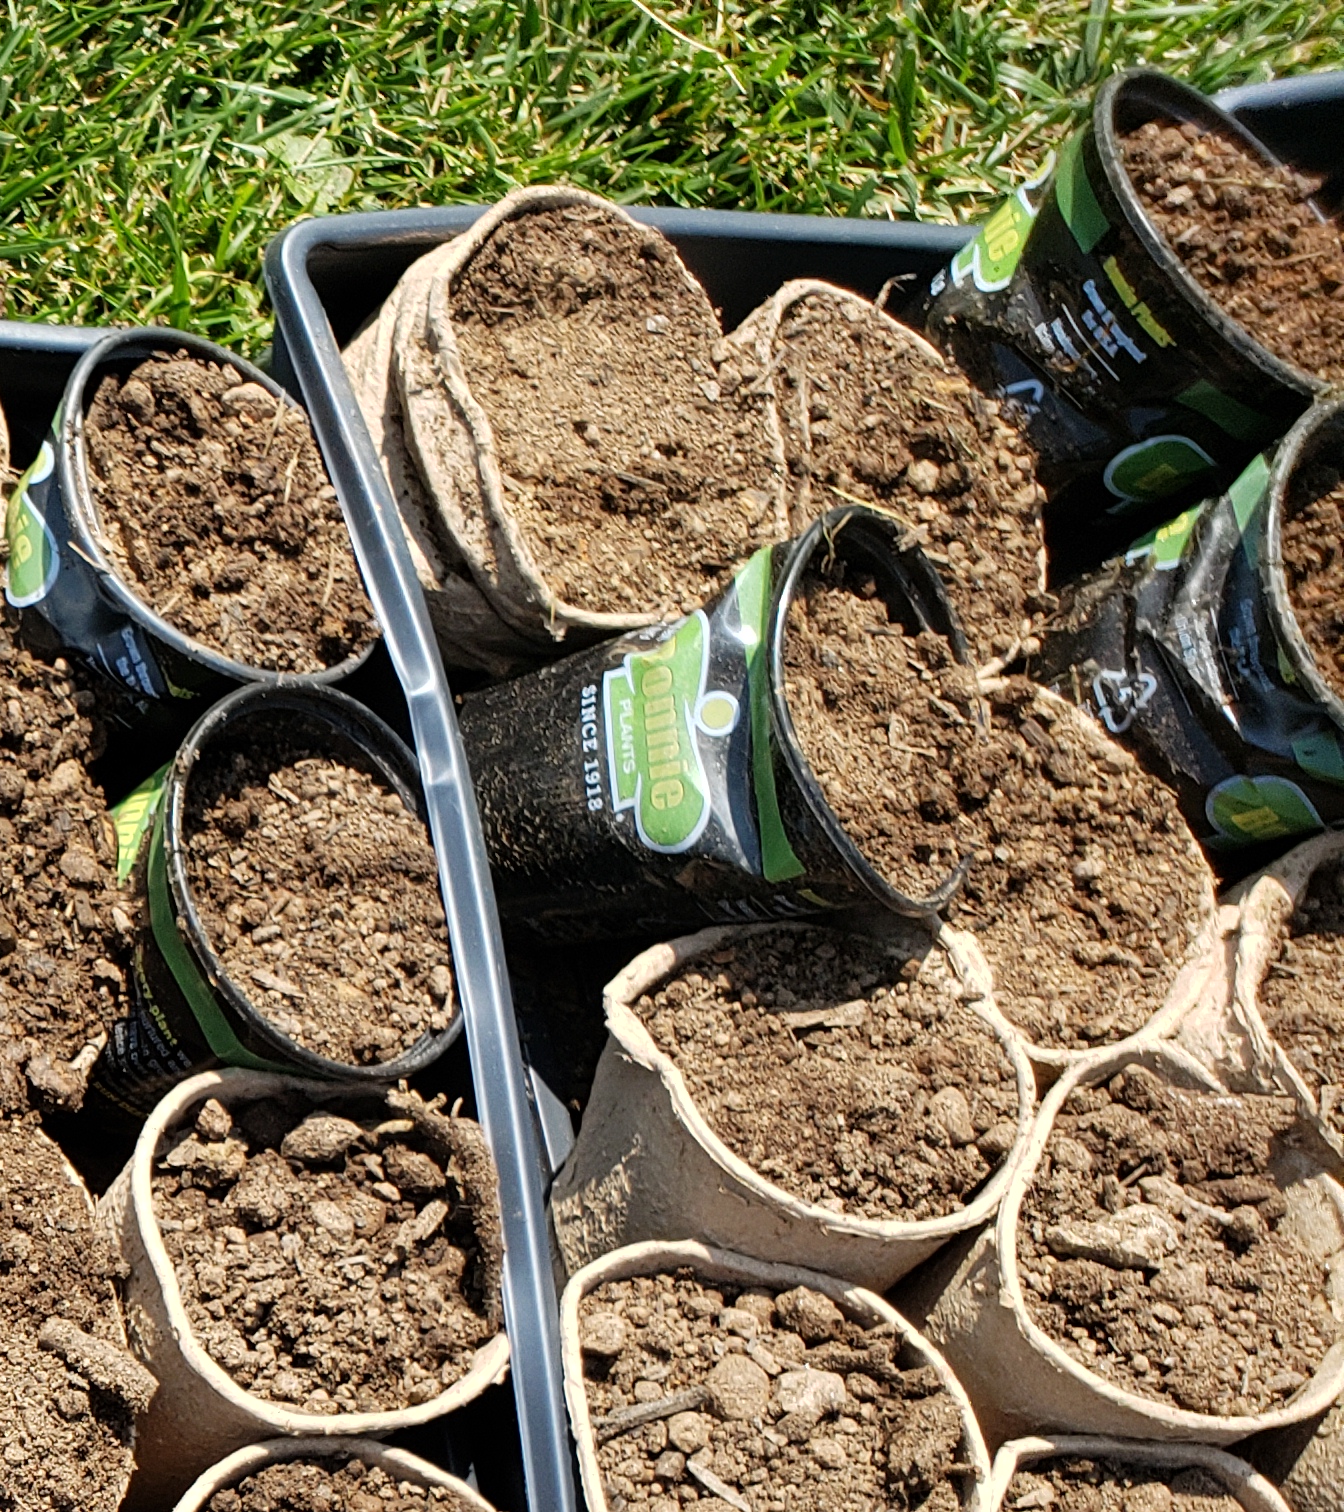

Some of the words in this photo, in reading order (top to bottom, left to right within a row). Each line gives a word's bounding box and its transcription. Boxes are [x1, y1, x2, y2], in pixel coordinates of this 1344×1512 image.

[581, 684, 598, 752] SINCE
[619, 697, 636, 774] PLANTS
[584, 759, 603, 811] 1918
[148, 1004, 177, 1045] plant
